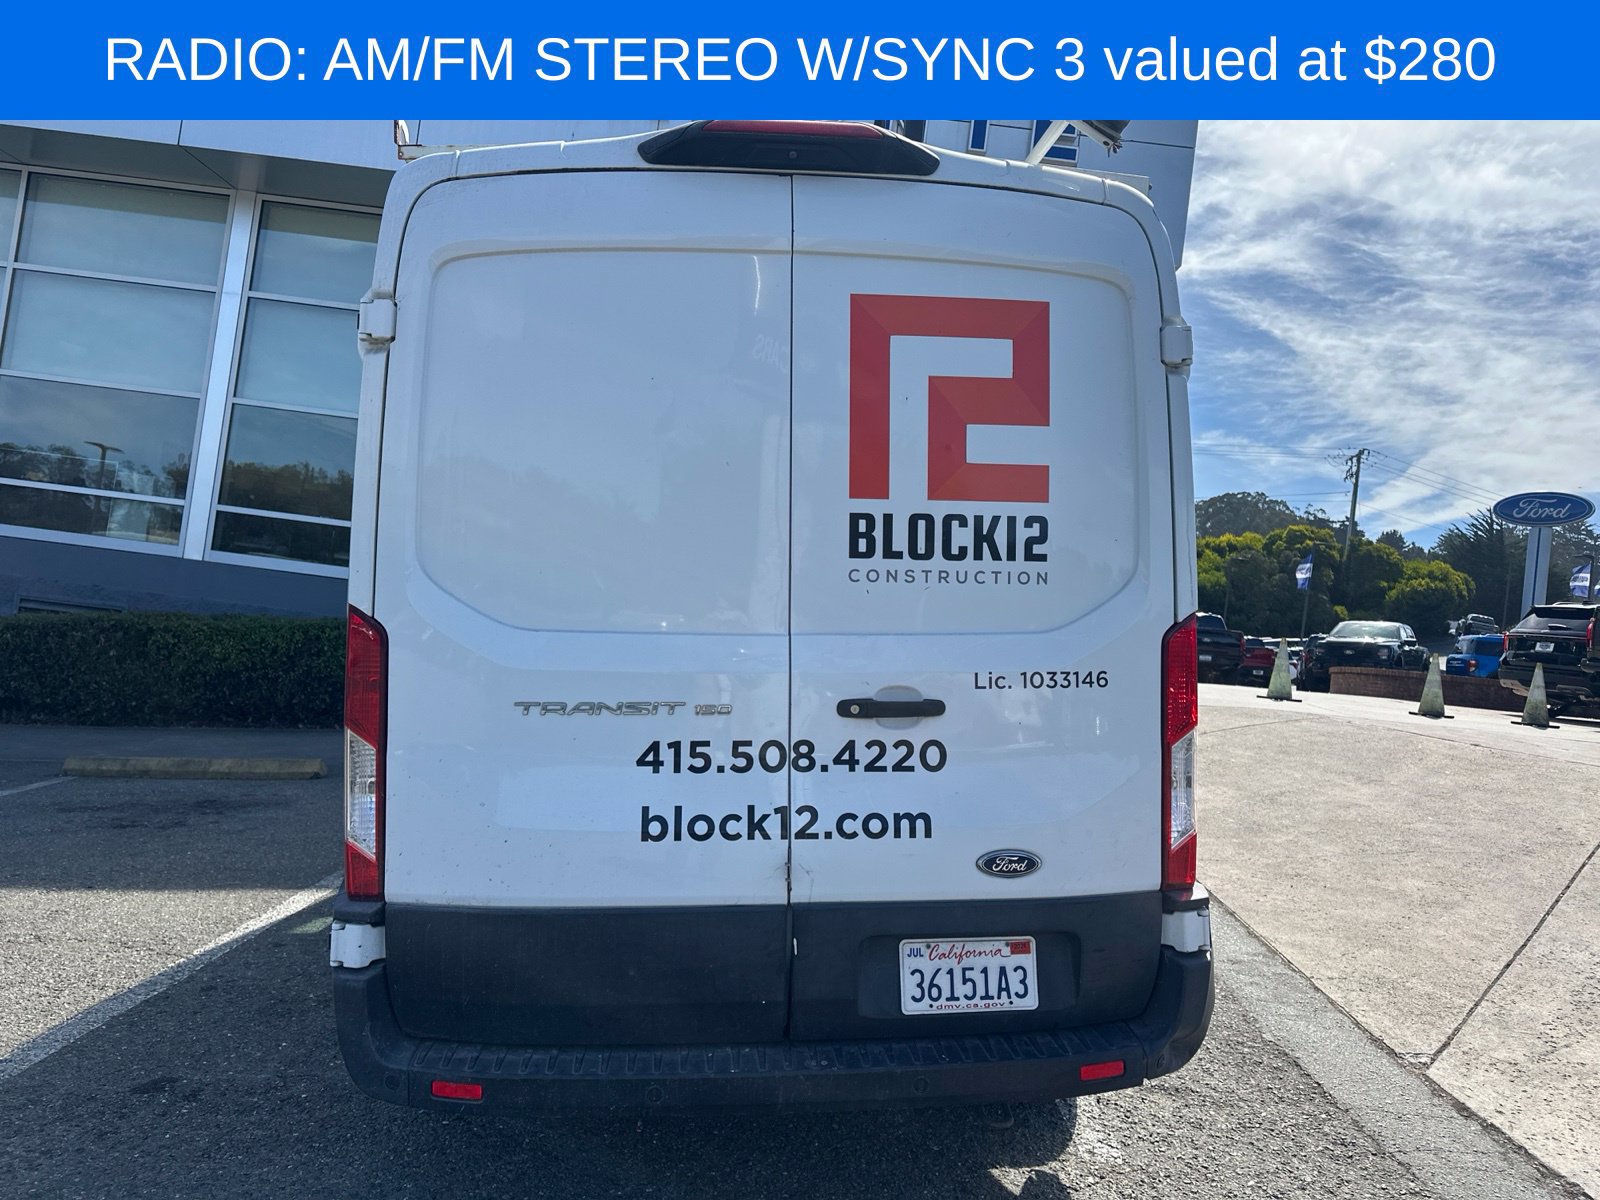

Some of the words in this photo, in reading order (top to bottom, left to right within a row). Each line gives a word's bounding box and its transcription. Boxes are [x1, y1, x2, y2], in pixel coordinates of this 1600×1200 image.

[1512, 498, 1571, 518] Ford
[847, 568, 1049, 586] CONSTRUCTION
[974, 671, 1012, 690] Lic.
[1020, 670, 1110, 689] 1033146
[514, 701, 686, 716] TRANSIT
[694, 704, 732, 716] 150
[635, 739, 949, 775] 415.508.4220
[640, 804, 933, 843] block12.com
[992, 856, 1028, 872] Ford
[907, 947, 924, 958] JUL
[928, 943, 1012, 965] California
[910, 965, 1029, 1003] 36151A3
[936, 1001, 1006, 1010] dmv.ca.gov
